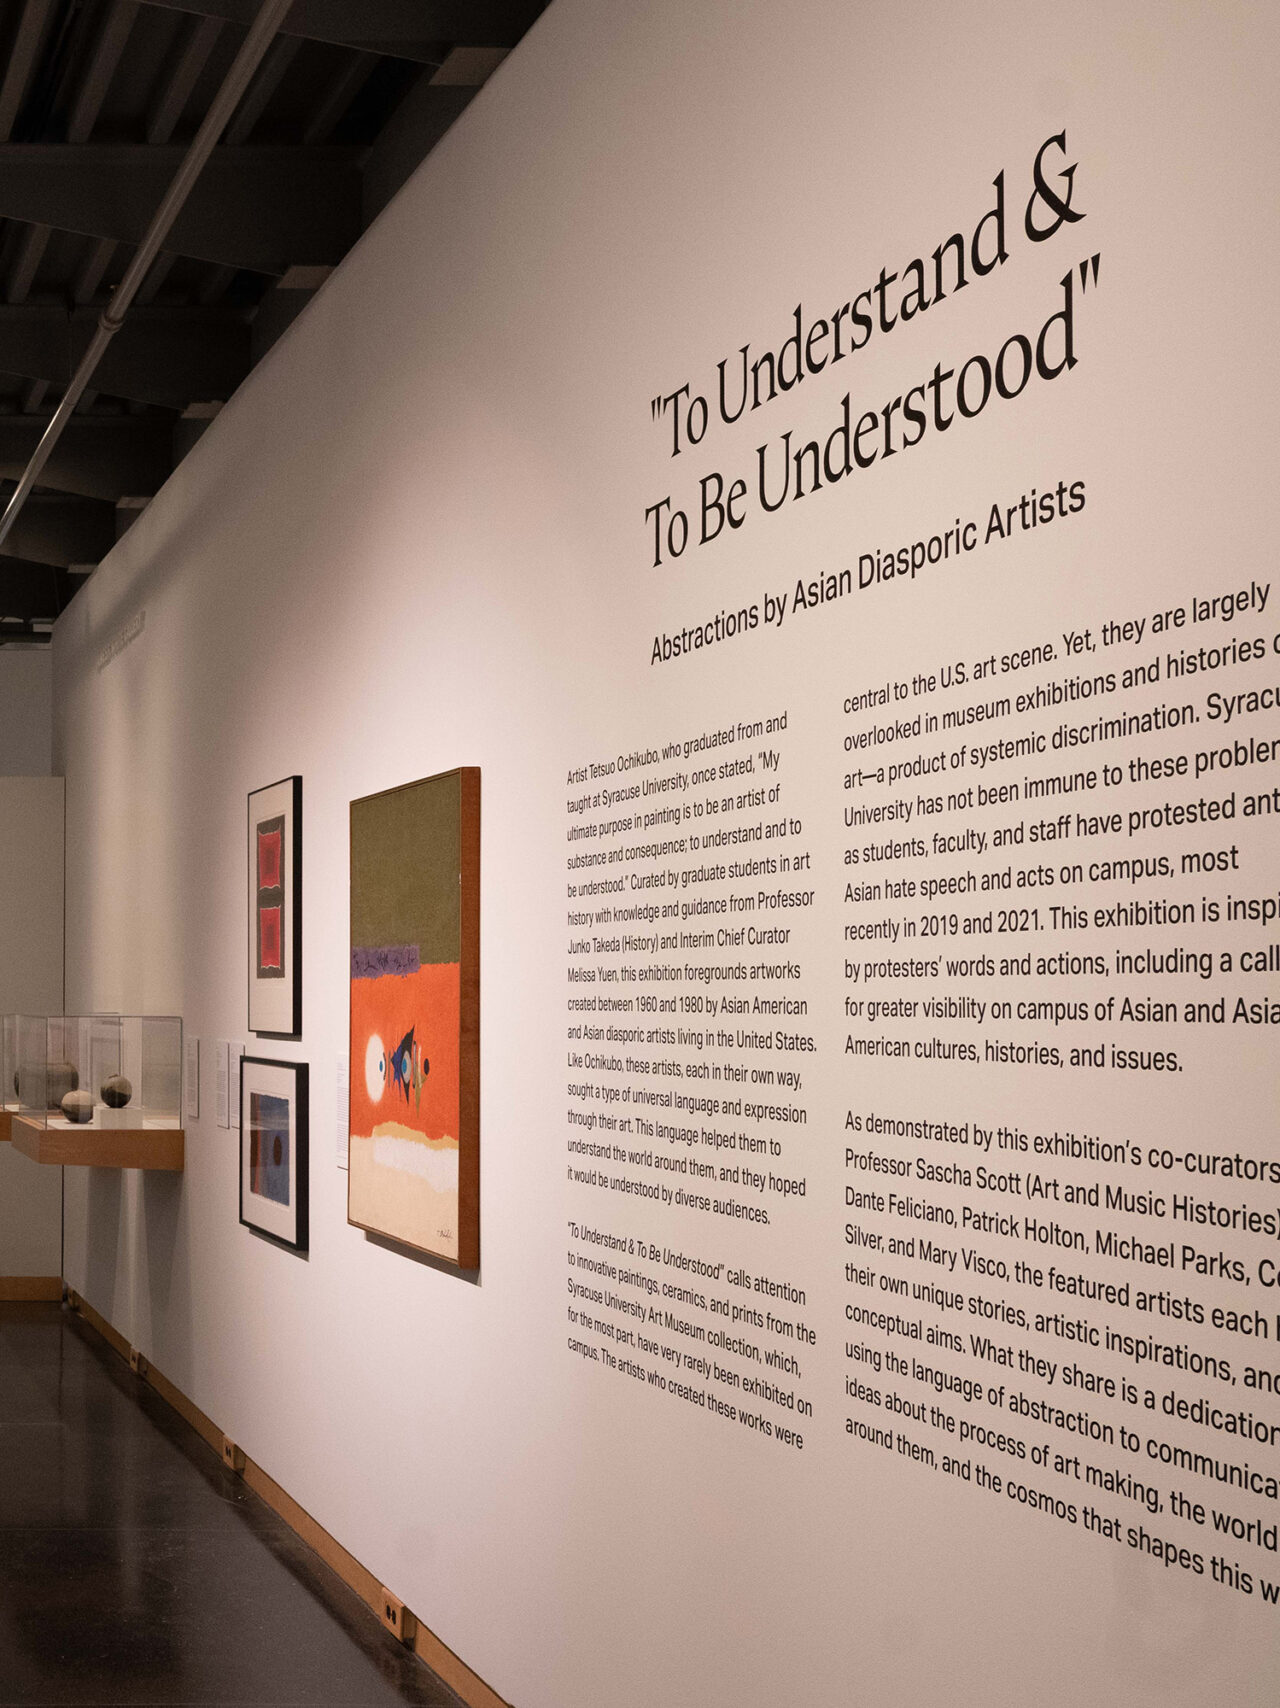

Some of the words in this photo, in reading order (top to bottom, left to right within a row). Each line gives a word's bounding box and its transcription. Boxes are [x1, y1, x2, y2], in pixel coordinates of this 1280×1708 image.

[651, 382, 708, 458] "To
[716, 168, 1010, 424] Understand
[1024, 129, 1087, 242] &
[645, 496, 688, 568] To
[698, 472, 747, 546] Be
[755, 252, 1100, 512] Understood"
[651, 605, 759, 665] Abstractions
[764, 593, 787, 627] by
[792, 571, 851, 613] Asian
[859, 518, 977, 589] Diasporic
[984, 481, 1085, 544] Artists
[844, 714, 921, 751] overlooked
[925, 712, 938, 734] in
[943, 698, 1010, 730] museum
[1016, 674, 1116, 713] exhibitions
[1122, 656, 1160, 689] and
[1167, 638, 1265, 679] histories
[567, 795, 591, 814] taught
[593, 792, 601, 808] at
[602, 785, 640, 808] Syracuse
[642, 772, 689, 796] University,
[692, 768, 716, 785] once
[719, 754, 755, 779] stated,
[845, 800, 913, 827] University
[917, 795, 943, 816] has
[948, 788, 974, 811] not
[978, 784, 1019, 806] been
[1024, 771, 1097, 799] immune
[1102, 764, 1123, 787] to
[1128, 756, 1188, 783] these
[567, 853, 606, 870] substance
[608, 846, 623, 863] and
[625, 839, 687, 861] consequence;
[689, 834, 700, 851] to
[702, 822, 762, 849] understand
[765, 818, 786, 839] and
[789, 818, 802, 835] to
[844, 881, 881, 903] Asian
[885, 878, 916, 899] hate
[920, 870, 976, 901] speech
[981, 866, 1011, 891] and
[1017, 865, 1054, 888] acts
[1060, 865, 1083, 884] on
[1089, 856, 1174, 884] campus,
[1181, 845, 1239, 874] most
[568, 911, 594, 928] history
[595, 907, 612, 923] with
[613, 903, 660, 923] knowledge
[662, 900, 679, 918] and
[681, 897, 727, 920] guidance
[729, 894, 755, 912] from
[758, 889, 815, 910] Professor
[568, 967, 596, 982] Melissa
[597, 966, 619, 983] Yuen,
[621, 965, 636, 981] this
[638, 964, 682, 981] exhibition
[684, 962, 747, 984] foregrounds
[750, 960, 800, 980] artworks
[845, 959, 860, 983] by
[864, 955, 942, 983] protesters’
[946, 954, 995, 977] words
[1000, 953, 1031, 976] and
[1036, 951, 1109, 977] actions,
[1116, 948, 1212, 979] including
[1220, 952, 1232, 973] a
[1240, 944, 1280, 972] call
[568, 1024, 581, 1039] and
[583, 1025, 604, 1040] Asian
[606, 1025, 644, 1046] diasporic
[646, 1027, 676, 1044] artists
[678, 1027, 703, 1050] living
[706, 1029, 714, 1046] in
[717, 1029, 734, 1047] the
[737, 1030, 772, 1049] United
[775, 1031, 817, 1052] States.
[845, 1034, 910, 1057] American
[914, 1037, 980, 1063] cultures,
[985, 1039, 1064, 1068] histories,
[1070, 1043, 1105, 1067] and
[1112, 1043, 1182, 1072] issues.
[568, 1082, 594, 1101] sought
[595, 1087, 600, 1099] a
[602, 1085, 620, 1104] type
[622, 1086, 631, 1102] of
[632, 1088, 672, 1107] universal
[674, 1091, 719, 1117] language
[722, 1098, 741, 1116] and
[744, 1103, 807, 1124] expression
[568, 1139, 611, 1159] understand
[613, 1145, 626, 1162] the
[628, 1150, 652, 1167] world
[654, 1156, 687, 1174] around
[689, 1157, 717, 1182] them,
[719, 1166, 739, 1184] and
[742, 1168, 766, 1193] they
[769, 1171, 806, 1197] hoped
[846, 1148, 912, 1177] Professor
[916, 1158, 971, 1187] Sascha
[976, 1166, 1021, 1195] Scott
[1026, 1173, 1059, 1201] (Art
[1064, 1183, 1099, 1207] and
[1106, 1184, 1166, 1217] Music
[581, 1225, 627, 1253] Understand
[628, 1238, 635, 1255] &
[637, 1240, 647, 1259] To
[649, 1244, 661, 1263] Be
[727, 1269, 751, 1290] calls
[754, 1276, 806, 1306] attention
[845, 1224, 884, 1254] Silver,
[888, 1237, 915, 1258] and
[919, 1239, 957, 1272] Mary
[961, 1248, 1010, 1282] Visco,
[1014, 1261, 1043, 1287] the
[1048, 1267, 1129, 1307] featured
[1136, 1291, 1204, 1324] artists
[1211, 1308, 1268, 1339] each
[568, 1278, 603, 1304] Syracuse
[604, 1290, 647, 1323] University
[648, 1306, 663, 1326] Art
[665, 1311, 705, 1344] Museum
[707, 1330, 762, 1365] collection,
[764, 1348, 801, 1379] which,
[845, 1305, 922, 1341] conceptual
[926, 1324, 966, 1354] aims.
[970, 1334, 1014, 1368] What
[1018, 1349, 1057, 1385] they
[1062, 1363, 1116, 1398] share
[1122, 1377, 1138, 1404] is
[1144, 1390, 1155, 1410] a
[568, 1338, 599, 1361] campus.
[601, 1348, 616, 1368] The
[618, 1359, 645, 1381] artists
[647, 1370, 666, 1390] who
[668, 1380, 705, 1407] created
[707, 1393, 736, 1420] these
[739, 1409, 772, 1436] works
[775, 1425, 803, 1449] were
[845, 1375, 881, 1406] ideas
[885, 1392, 927, 1423] about
[930, 1406, 955, 1433] the
[960, 1420, 1026, 1459] process
[1031, 1445, 1050, 1467] of
[1054, 1454, 1081, 1480] art
[1086, 1465, 1163, 1514] making,
[1170, 1491, 1205, 1525] the
[1211, 1510, 1278, 1552] world
